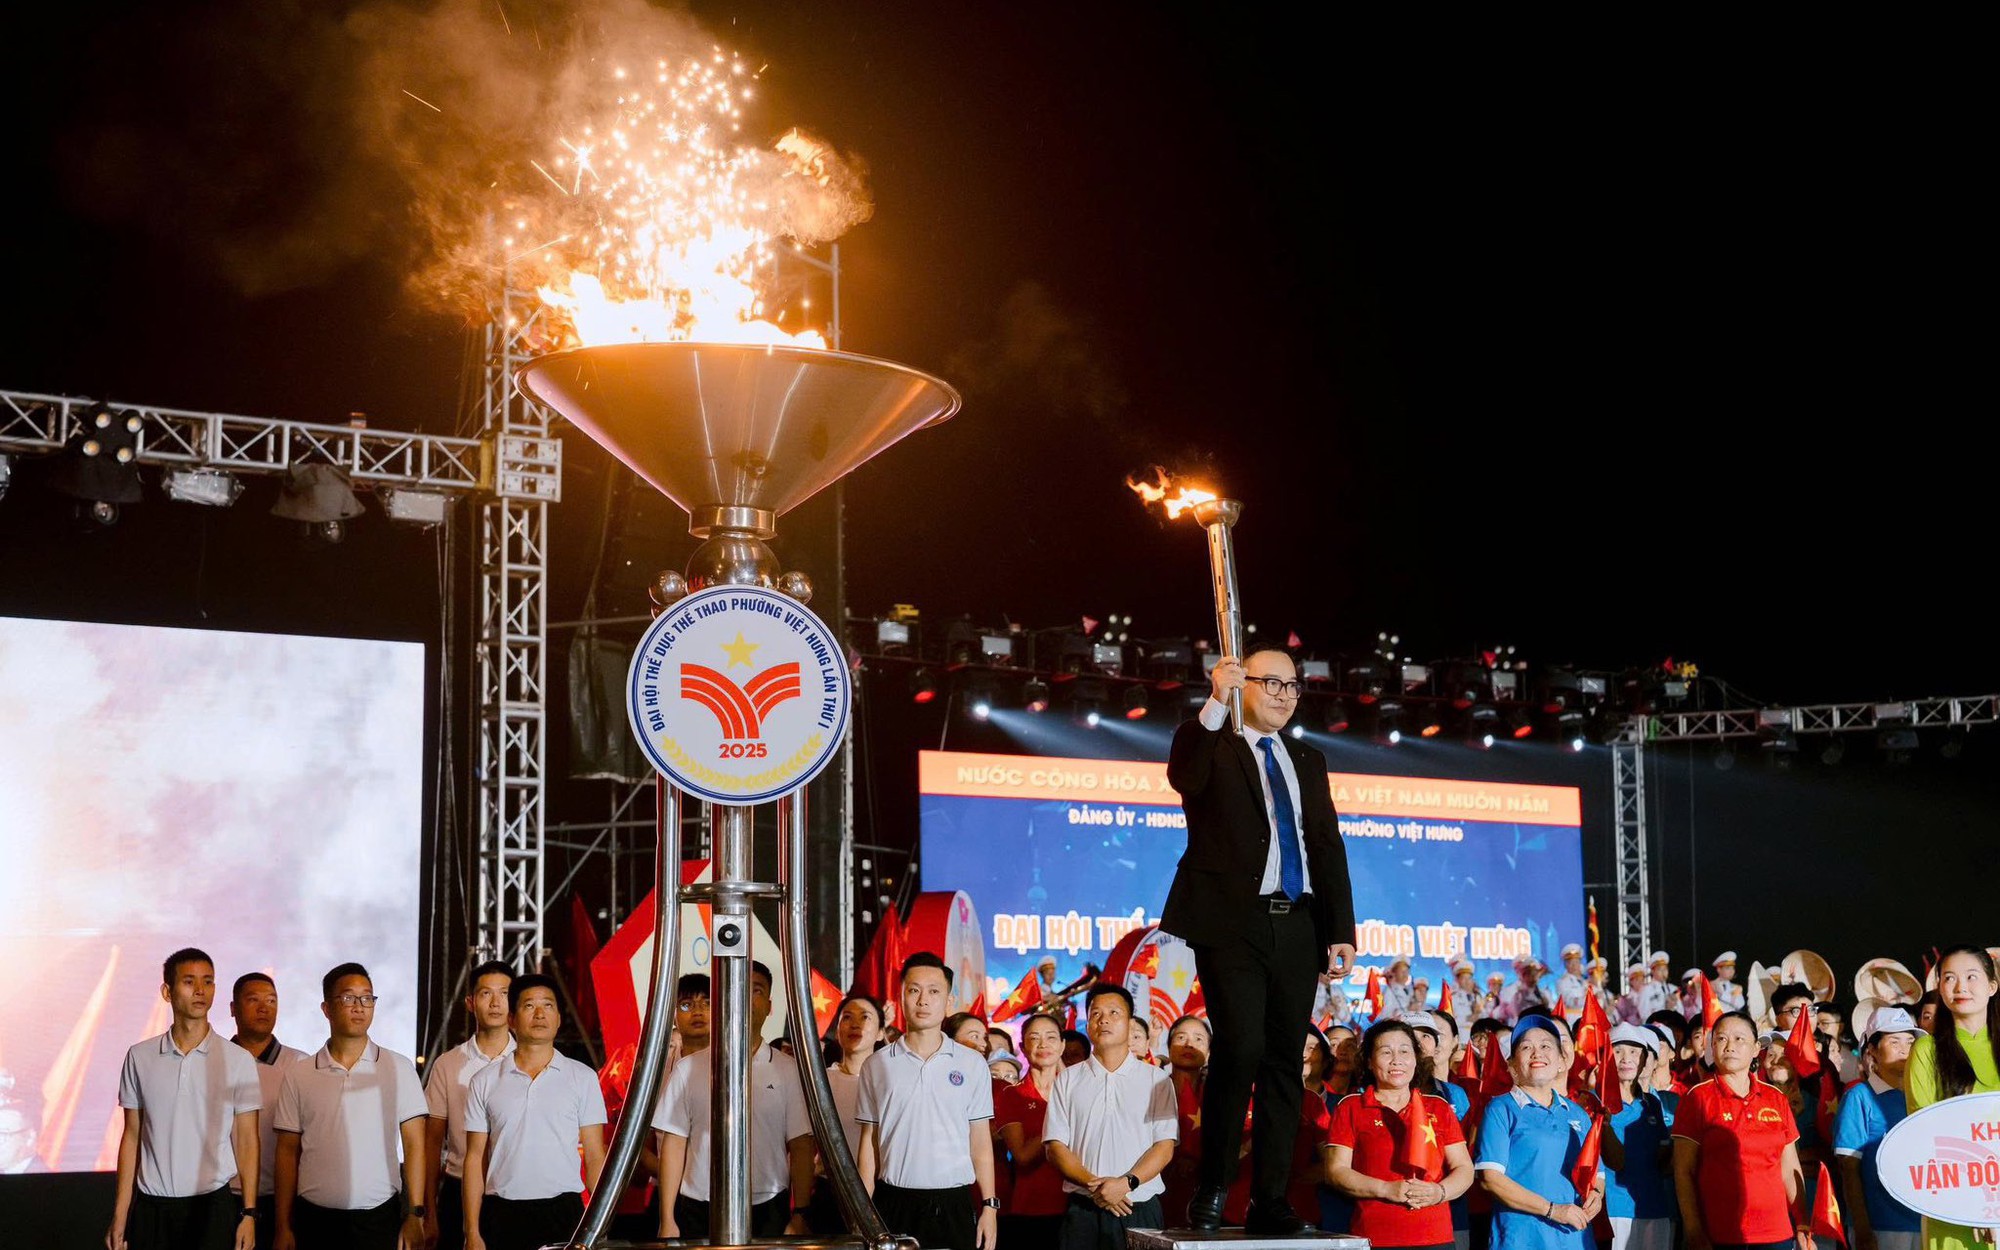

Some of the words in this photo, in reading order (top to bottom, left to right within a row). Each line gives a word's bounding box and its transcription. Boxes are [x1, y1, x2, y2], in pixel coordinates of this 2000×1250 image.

[694, 599, 728, 619] THAO
[731, 597, 783, 619] PHƯỜNG
[671, 608, 696, 634] THỂ
[784, 611, 810, 636] VIỆT
[653, 631, 677, 657] DỤC
[805, 632, 831, 666] HƯNG
[645, 655, 662, 680] THỂ
[642, 684, 660, 706] HỘI
[647, 709, 665, 732] ĐẠI
[820, 697, 837, 723] THỨ
[818, 721, 830, 730] I
[718, 743, 767, 759] 2025
[956, 765, 1024, 787] NƯỚC
[1029, 768, 1098, 793] CỘNG
[1103, 772, 1152, 793] HÒA
[1355, 783, 1393, 809] VIỆT
[1397, 789, 1443, 808] NAM
[1448, 789, 1502, 811] MUÔN
[1507, 792, 1550, 814] NĂM
[1068, 804, 1114, 827] ĐẢNG
[1115, 805, 1136, 827] ỦY
[1397, 822, 1423, 844] VIỆT
[993, 913, 1042, 955] ĐẠI
[1045, 910, 1093, 956] HỘI
[1416, 920, 1468, 963] VIỆT
[1470, 923, 1532, 960] HƯNG
[1970, 1121, 2000, 1142] KH
[1908, 1158, 1960, 1195] VẬN
[1967, 1155, 2000, 1192] ĐỘ
